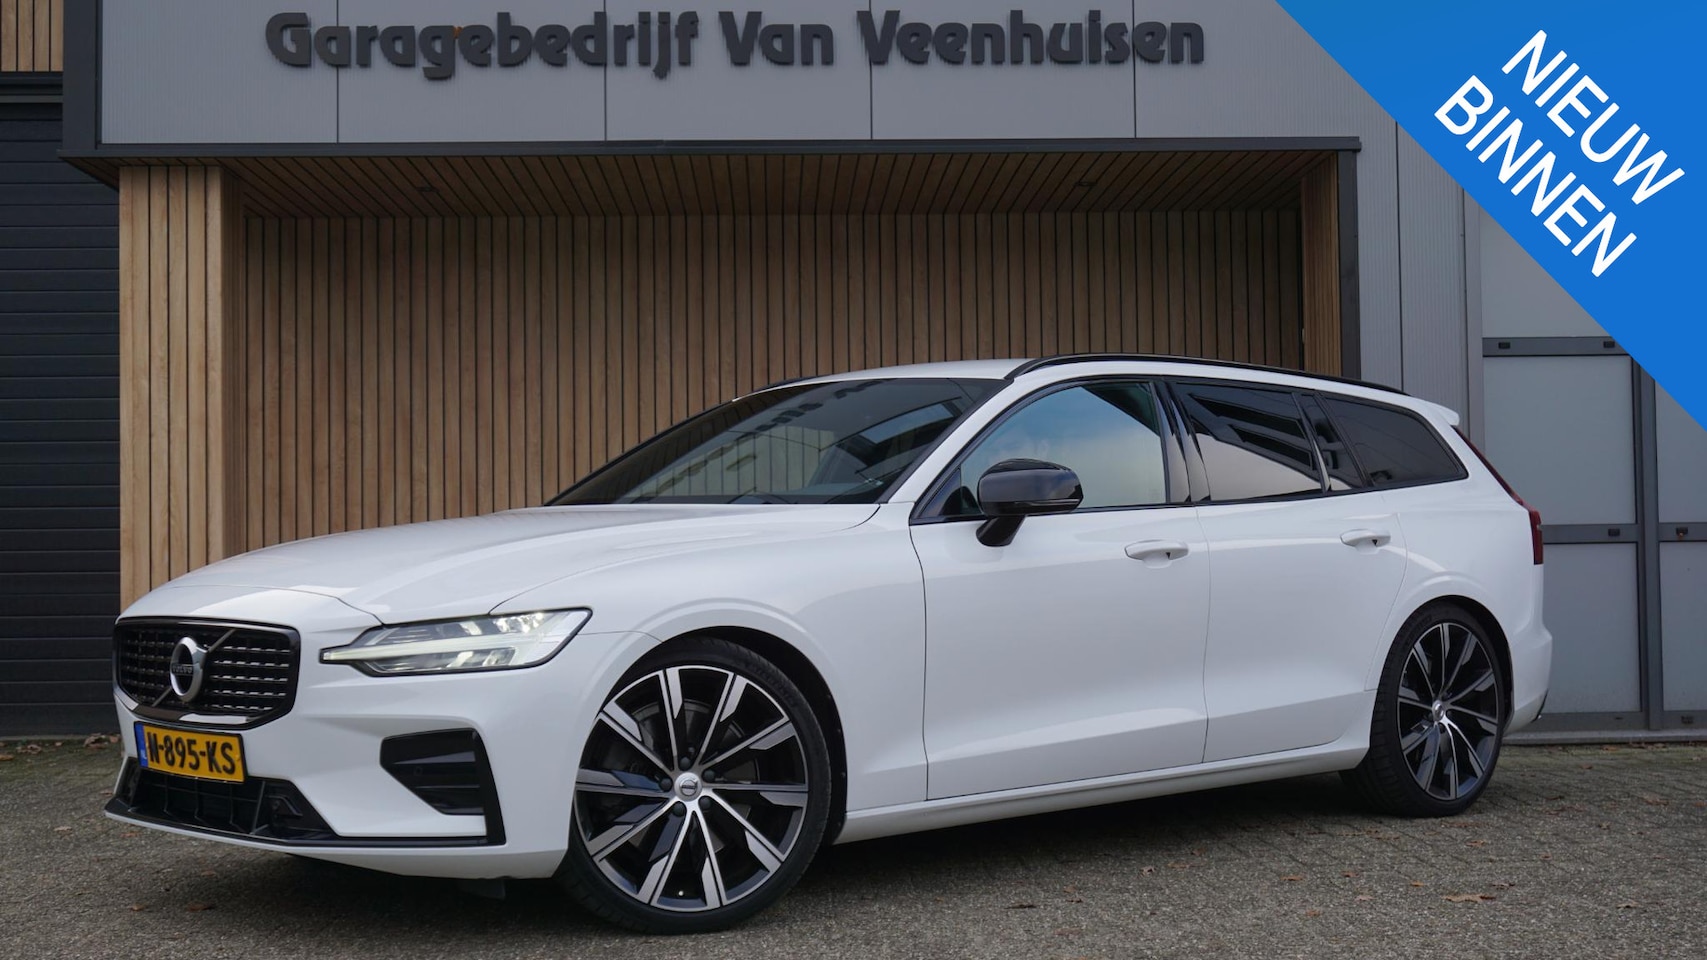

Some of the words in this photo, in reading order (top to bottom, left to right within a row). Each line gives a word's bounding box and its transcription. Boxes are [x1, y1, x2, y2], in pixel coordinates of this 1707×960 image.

[265, 11, 699, 80] Garagebedrijf
[718, 10, 834, 66] Van
[856, 9, 1204, 65] Veenhuisen
[147, 731, 236, 775] N-895-KS
